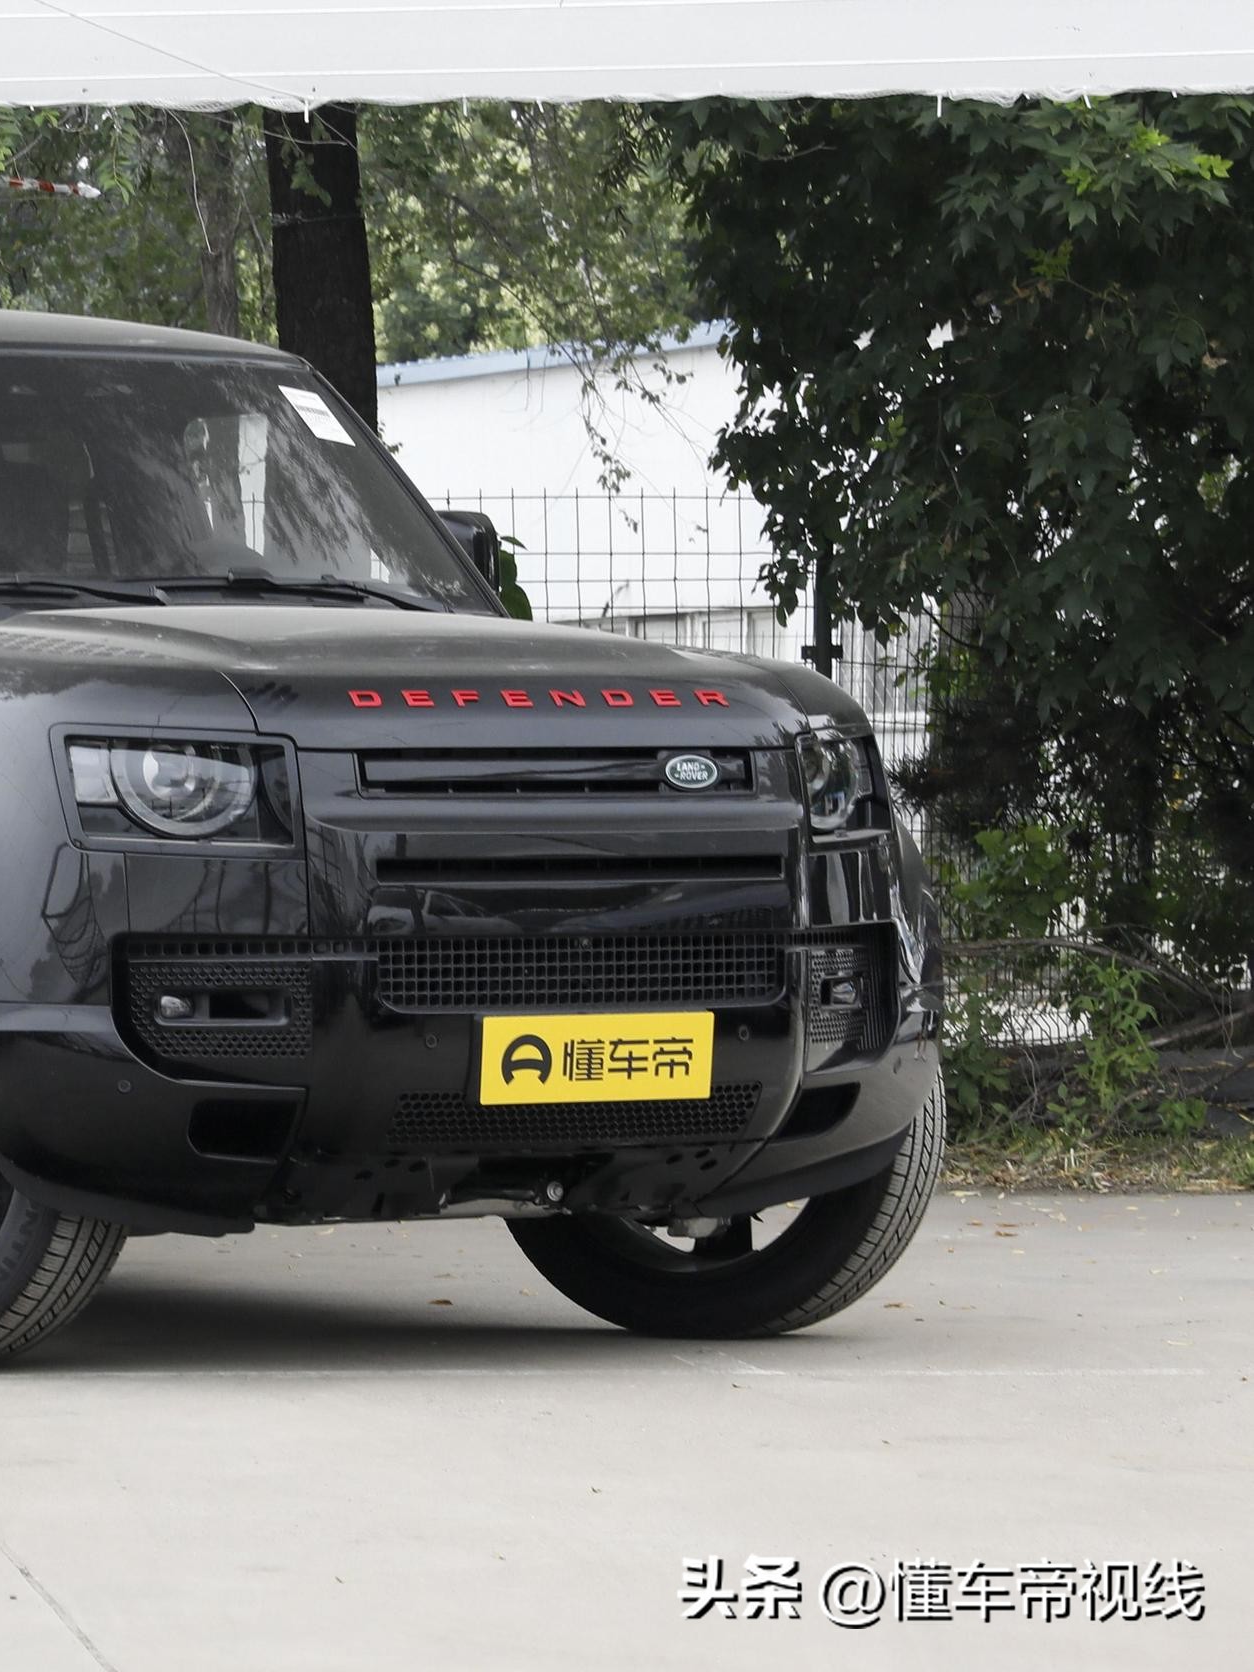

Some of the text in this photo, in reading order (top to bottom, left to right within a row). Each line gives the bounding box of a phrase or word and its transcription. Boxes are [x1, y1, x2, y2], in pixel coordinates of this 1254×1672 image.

[348, 688, 731, 709] DEFENDER
[676, 761, 700, 772] LAND
[679, 770, 709, 781] ROVER
[562, 1036, 695, 1082] 懂车帝
